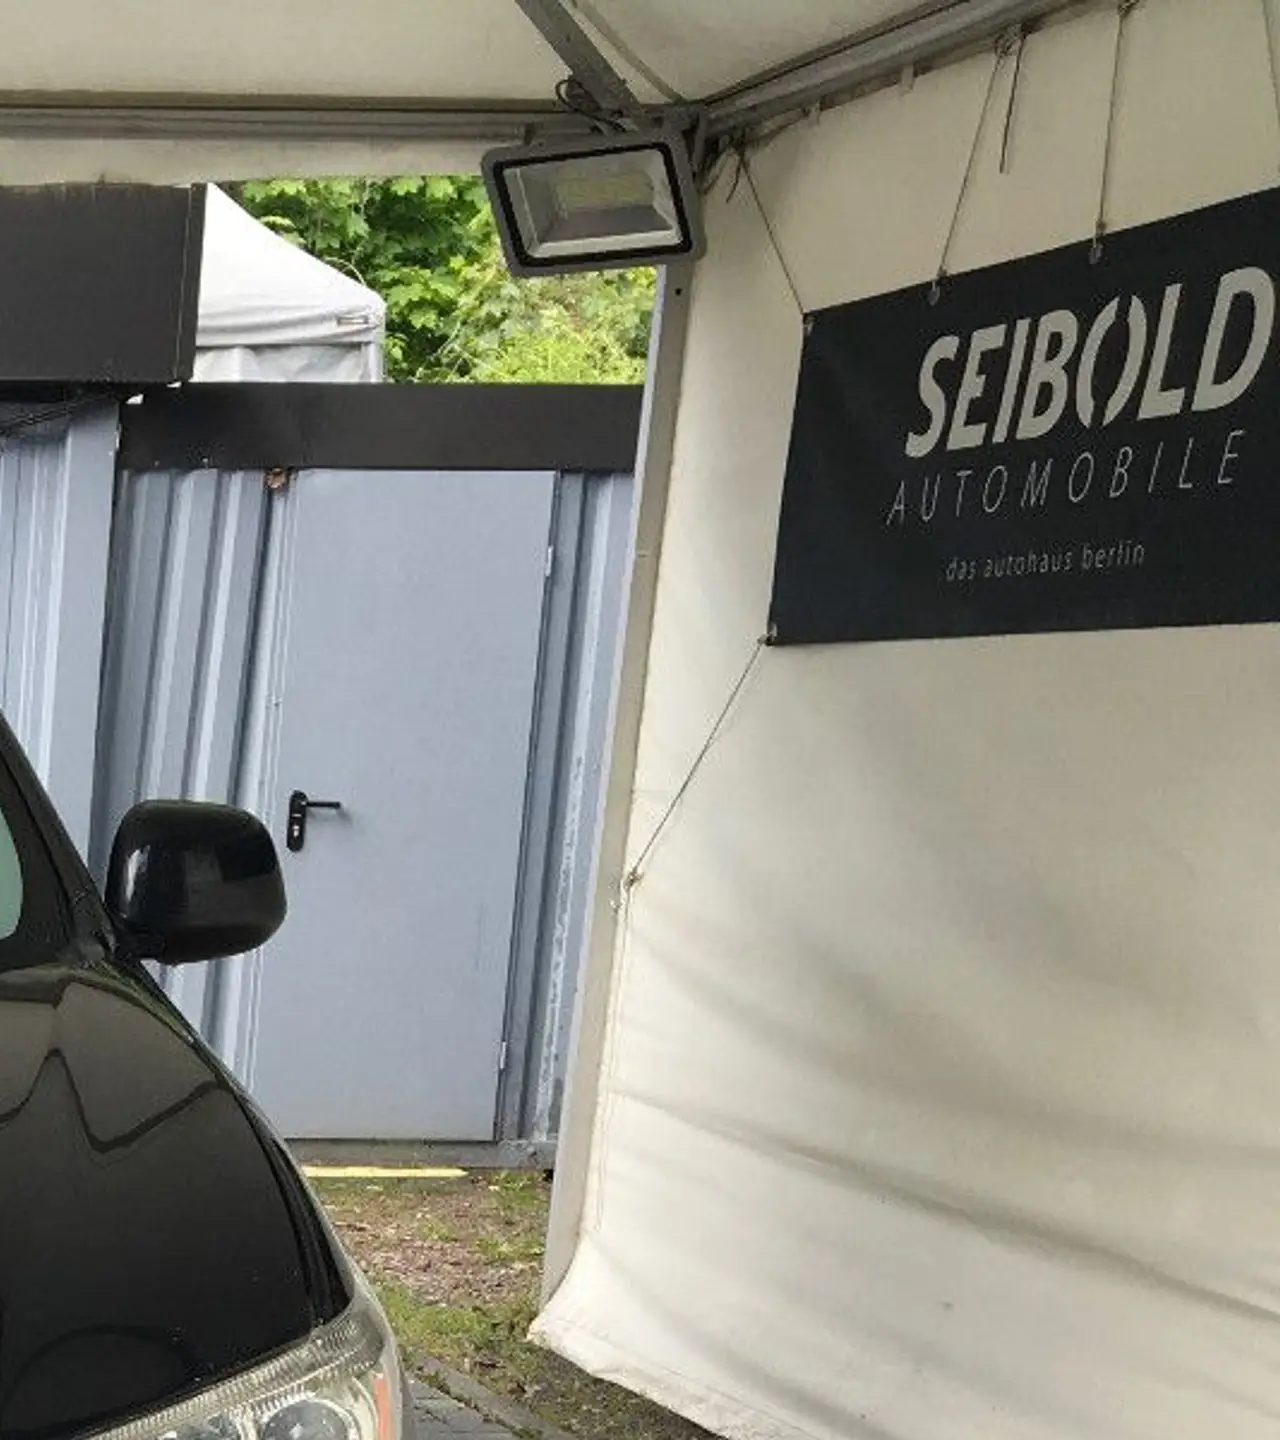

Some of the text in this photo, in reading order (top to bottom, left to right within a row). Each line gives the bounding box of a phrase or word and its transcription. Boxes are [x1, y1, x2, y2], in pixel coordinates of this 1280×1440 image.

[903, 266, 1274, 458] SEIBOLD
[886, 430, 1244, 525] AUTOMOBILE
[946, 541, 1145, 581] das autohaus berlin
